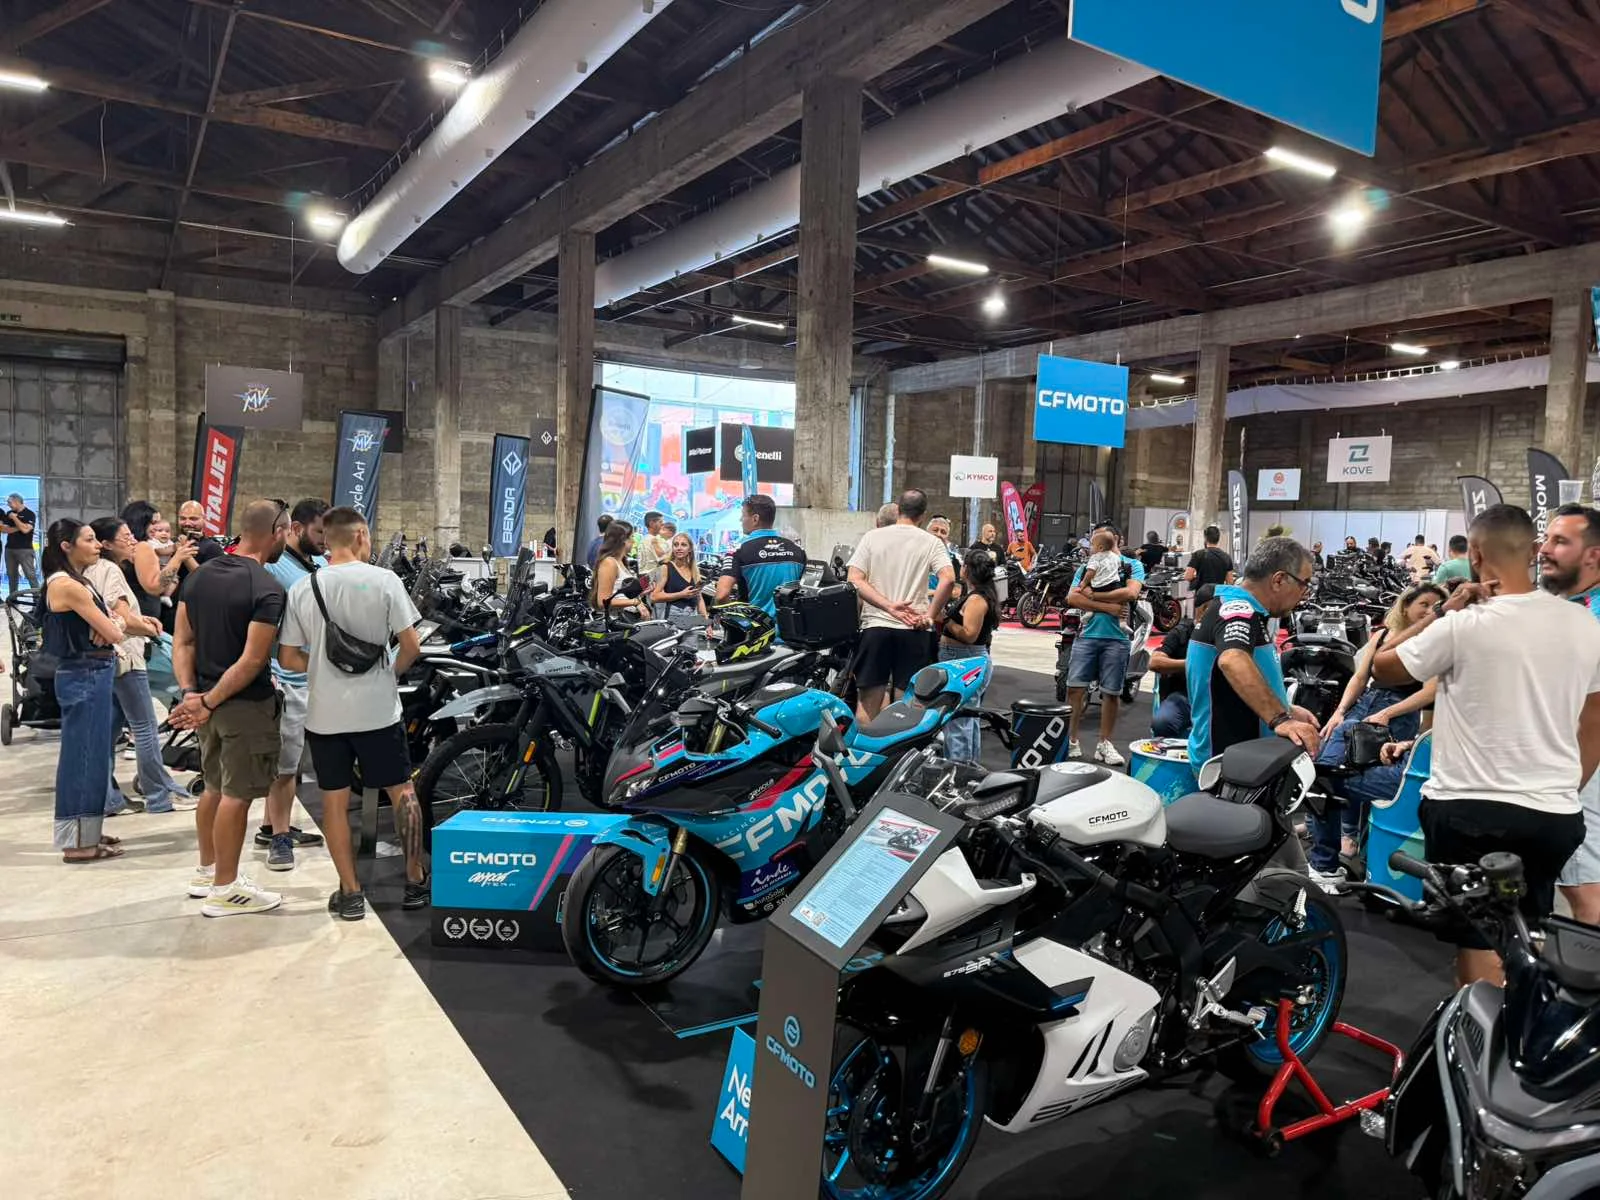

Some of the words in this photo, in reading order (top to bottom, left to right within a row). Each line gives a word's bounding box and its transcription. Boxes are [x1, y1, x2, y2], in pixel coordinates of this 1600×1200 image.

[1038, 389, 1124, 415] CFMOTO
[755, 450, 782, 461] enelli
[352, 461, 367, 481] Art
[1342, 466, 1373, 475] KOVE
[205, 437, 229, 534] ITALJET
[1472, 489, 1487, 516] ZO
[1018, 716, 1065, 769] OTO
[658, 762, 696, 783] CFMOTO
[481, 816, 562, 826] CFMOTO
[1088, 810, 1128, 824] CFMOTO
[450, 851, 537, 867] CFMOTO
[766, 1035, 815, 1088] CFMOTO
[728, 1063, 752, 1108] Ne
[720, 1097, 748, 1142] Arr
